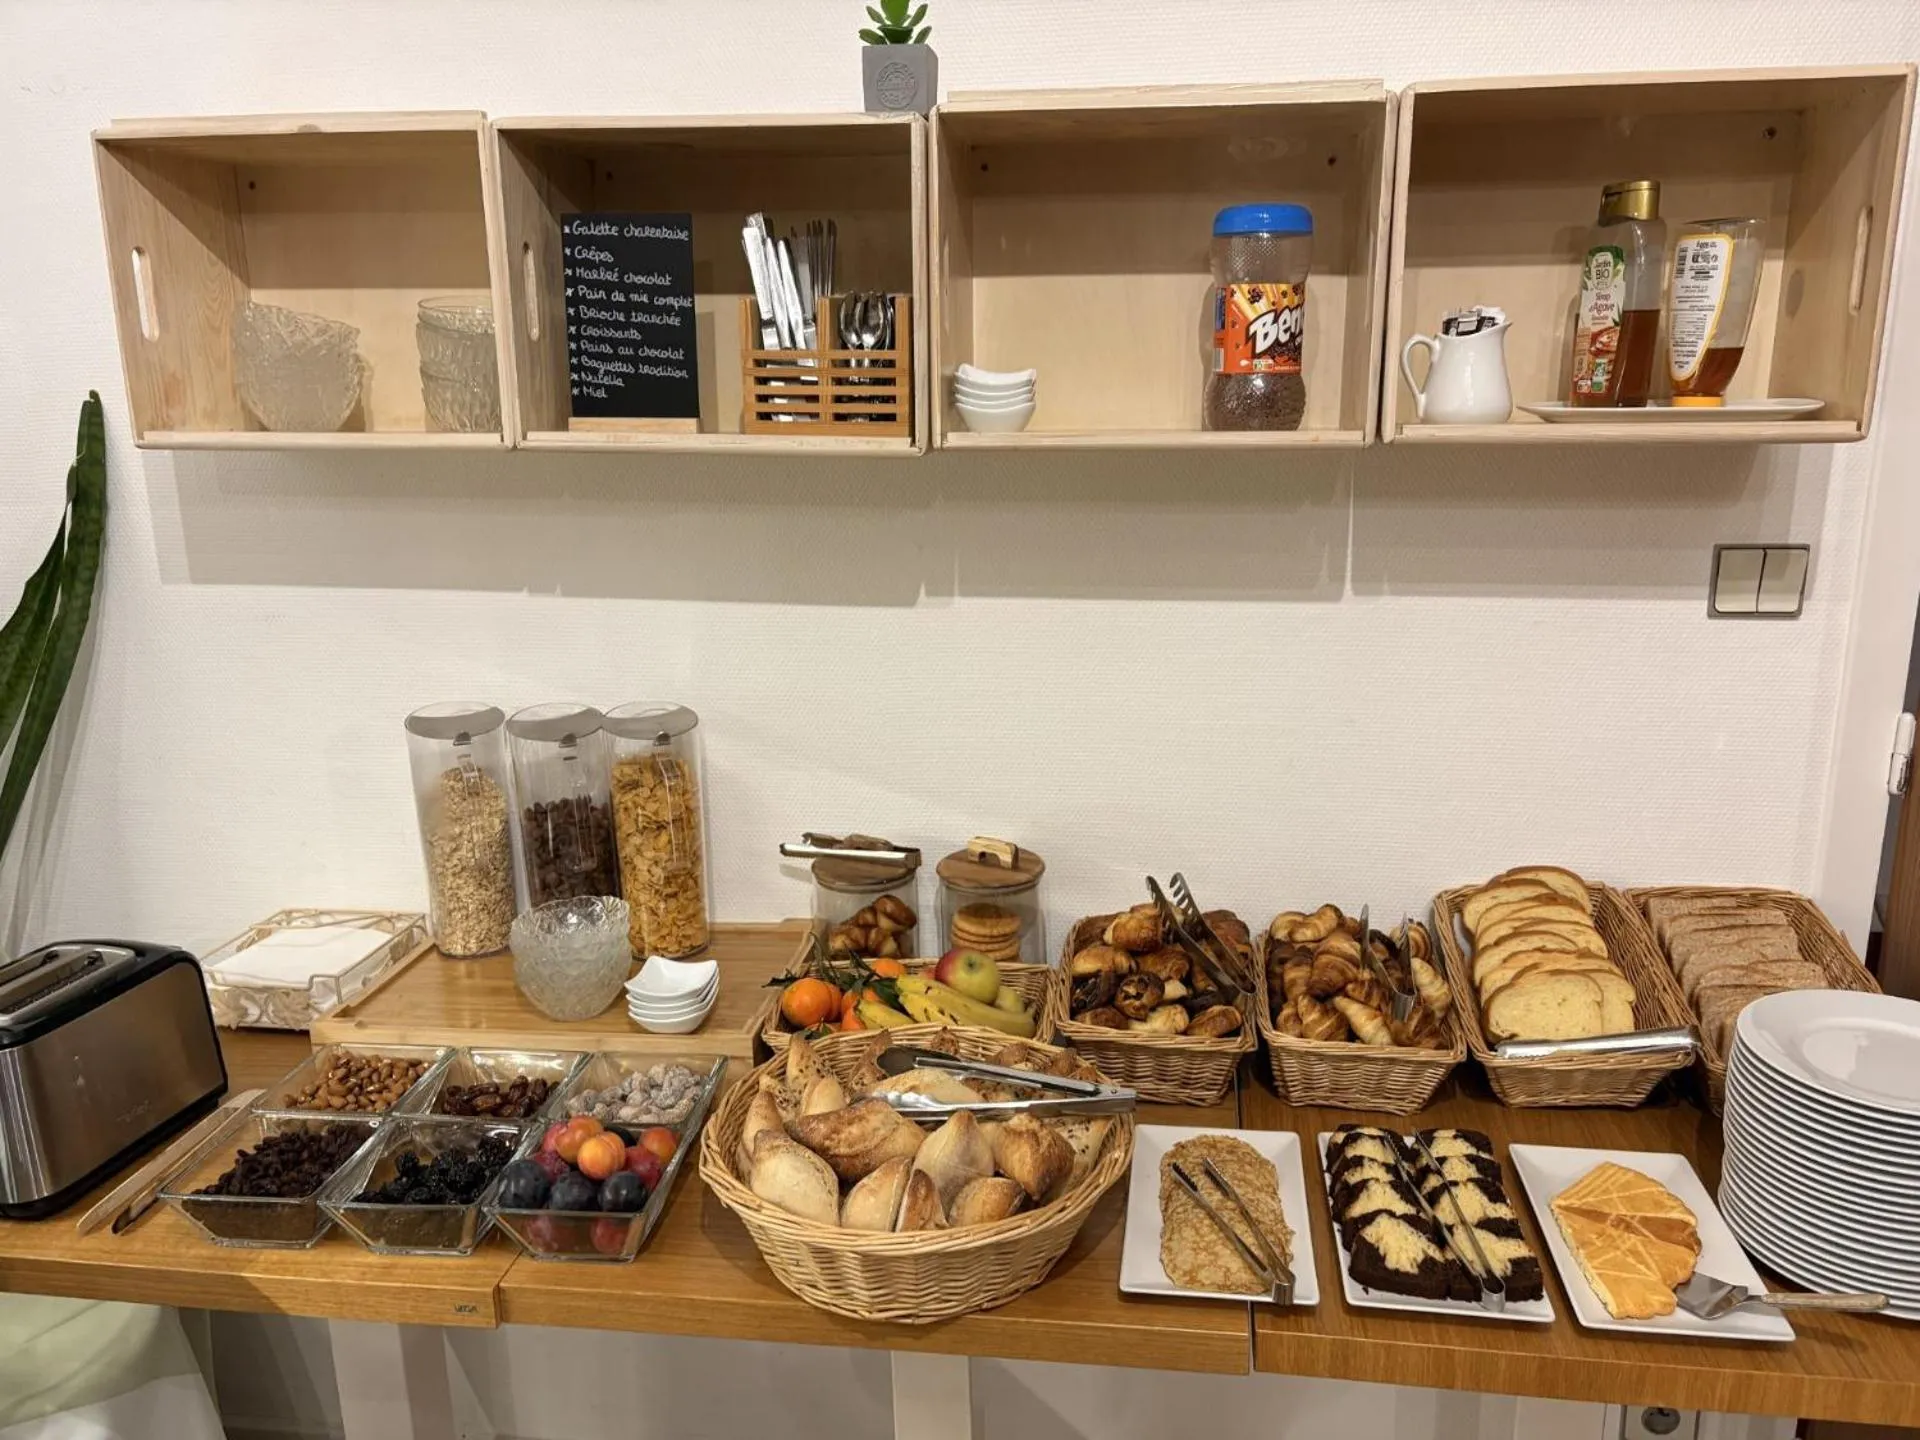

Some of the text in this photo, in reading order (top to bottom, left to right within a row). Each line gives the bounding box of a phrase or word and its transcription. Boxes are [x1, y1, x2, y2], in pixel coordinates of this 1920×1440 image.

[573, 220, 689, 241] Galette charentaise
[575, 246, 614, 264] Crêpes
[576, 267, 672, 285] Marbré chocolat
[578, 285, 692, 310] Pain de mie complet
[580, 304, 681, 326] Brioche tranchée
[580, 324, 642, 340] Croissants
[1248, 306, 1304, 355] Ben
[580, 339, 685, 360] Pains au chocolat
[580, 355, 689, 379] Baguettes tradition
[581, 371, 625, 387] Nutella
[583, 386, 608, 398] Miel
